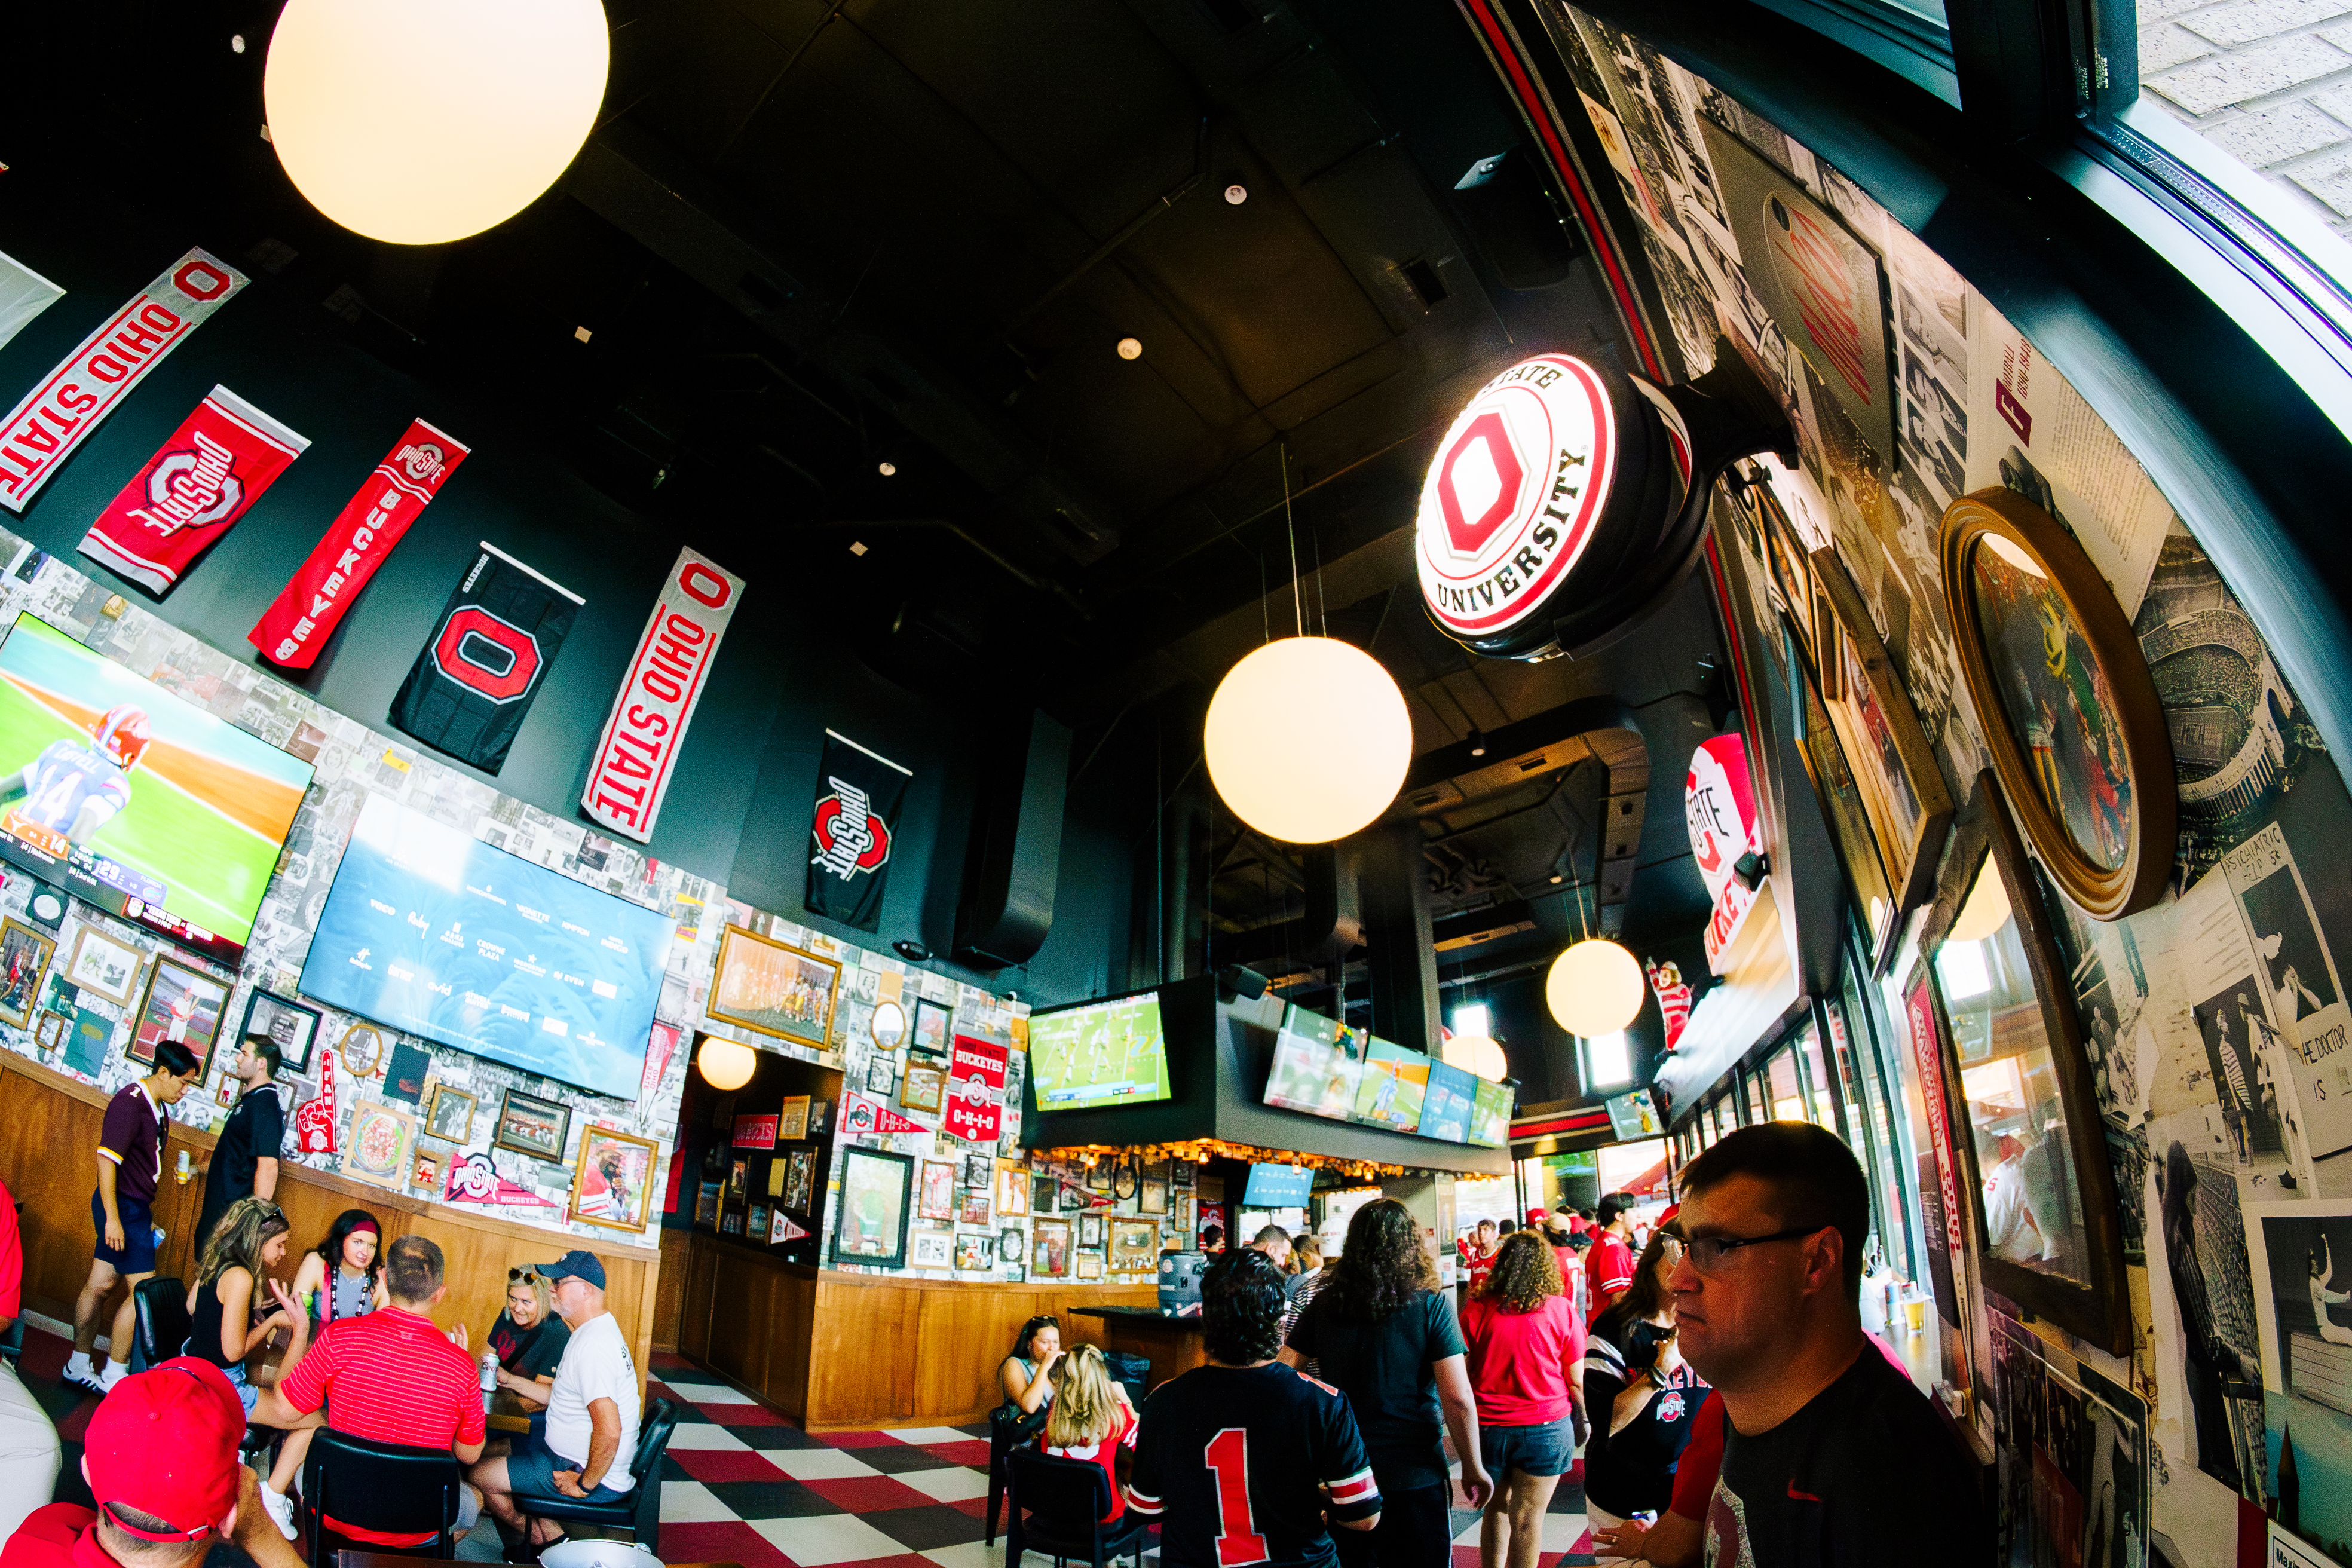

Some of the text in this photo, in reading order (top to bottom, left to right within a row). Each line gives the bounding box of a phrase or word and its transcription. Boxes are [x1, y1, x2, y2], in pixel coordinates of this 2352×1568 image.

[87, 303, 181, 384] OHIO
[125, 430, 232, 537] OHIO STATE
[1437, 447, 1587, 614] UNIVERSITY
[274, 488, 402, 662] BUCKEYES
[597, 612, 706, 830] OHIO STATE
[810, 775, 870, 880] OHIO STATE
[49, 834, 68, 855] 14
[2225, 827, 2280, 874] PSYCHIATRIC
[98, 859, 121, 881] 29
[140, 875, 163, 890] FLORIDA
[516, 903, 550, 923] VIGNETTE
[408, 911, 430, 940] Ruby
[562, 921, 590, 937] KIMPTON
[477, 939, 506, 956] CROWNE
[478, 947, 500, 962] PLAZA
[601, 938, 629, 954] INDIGO
[387, 964, 415, 982] Garner
[564, 973, 585, 987] EVEN
[427, 981, 452, 997] avid
[465, 991, 491, 1005] ATWELL
[2314, 1024, 2348, 1059] DOCTOR
[955, 1049, 1004, 1073] BUCKEYES
[644, 1065, 653, 1090] STATE
[650, 1069, 659, 1090] OHIO
[2313, 1079, 2326, 1101] IS
[953, 1108, 994, 1130] O-H-I-O
[452, 1166, 501, 1201] OHIO STATE
[1946, 1170, 1961, 1251] OHIO
[1205, 1427, 1271, 1568] 1
